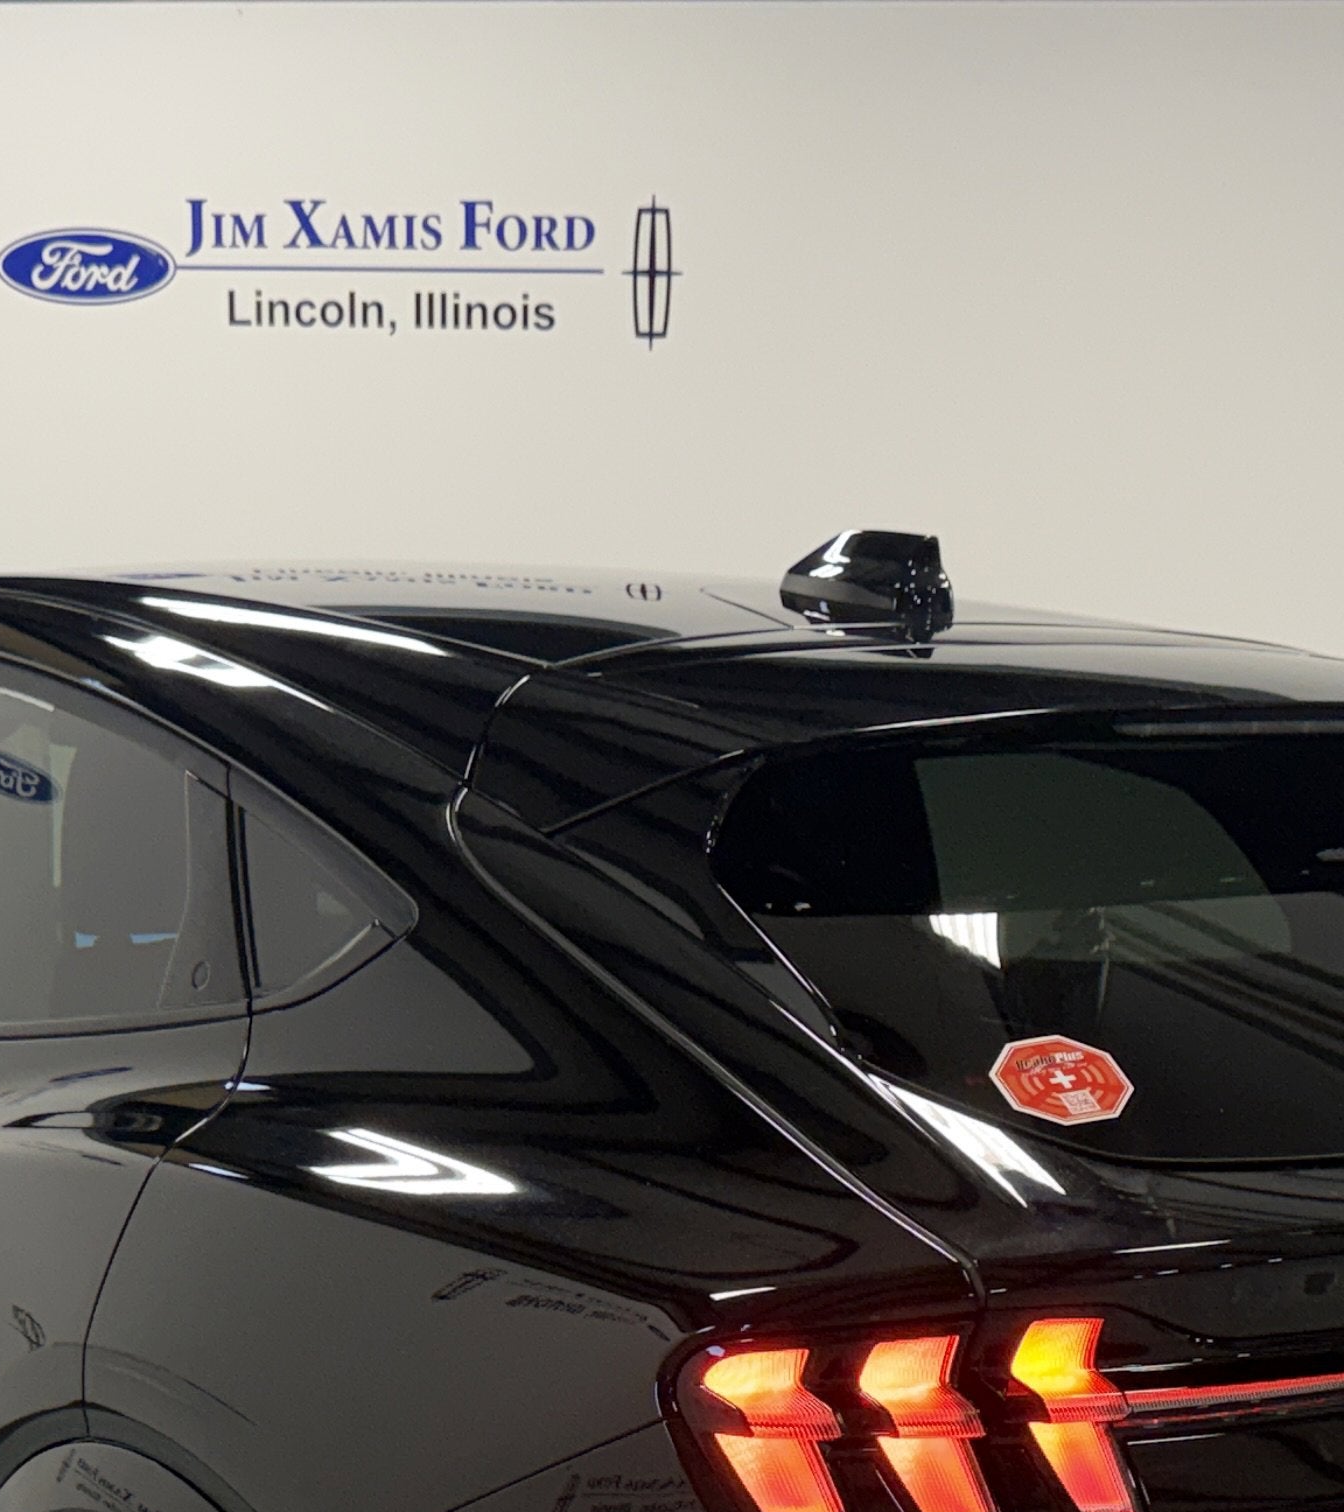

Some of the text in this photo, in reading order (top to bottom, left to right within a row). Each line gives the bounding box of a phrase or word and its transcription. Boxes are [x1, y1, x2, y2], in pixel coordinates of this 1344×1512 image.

[185, 200, 596, 257] JIM XAMIS FORD
[31, 240, 140, 292] Ford
[227, 290, 556, 336] Lincoln, Illinois
